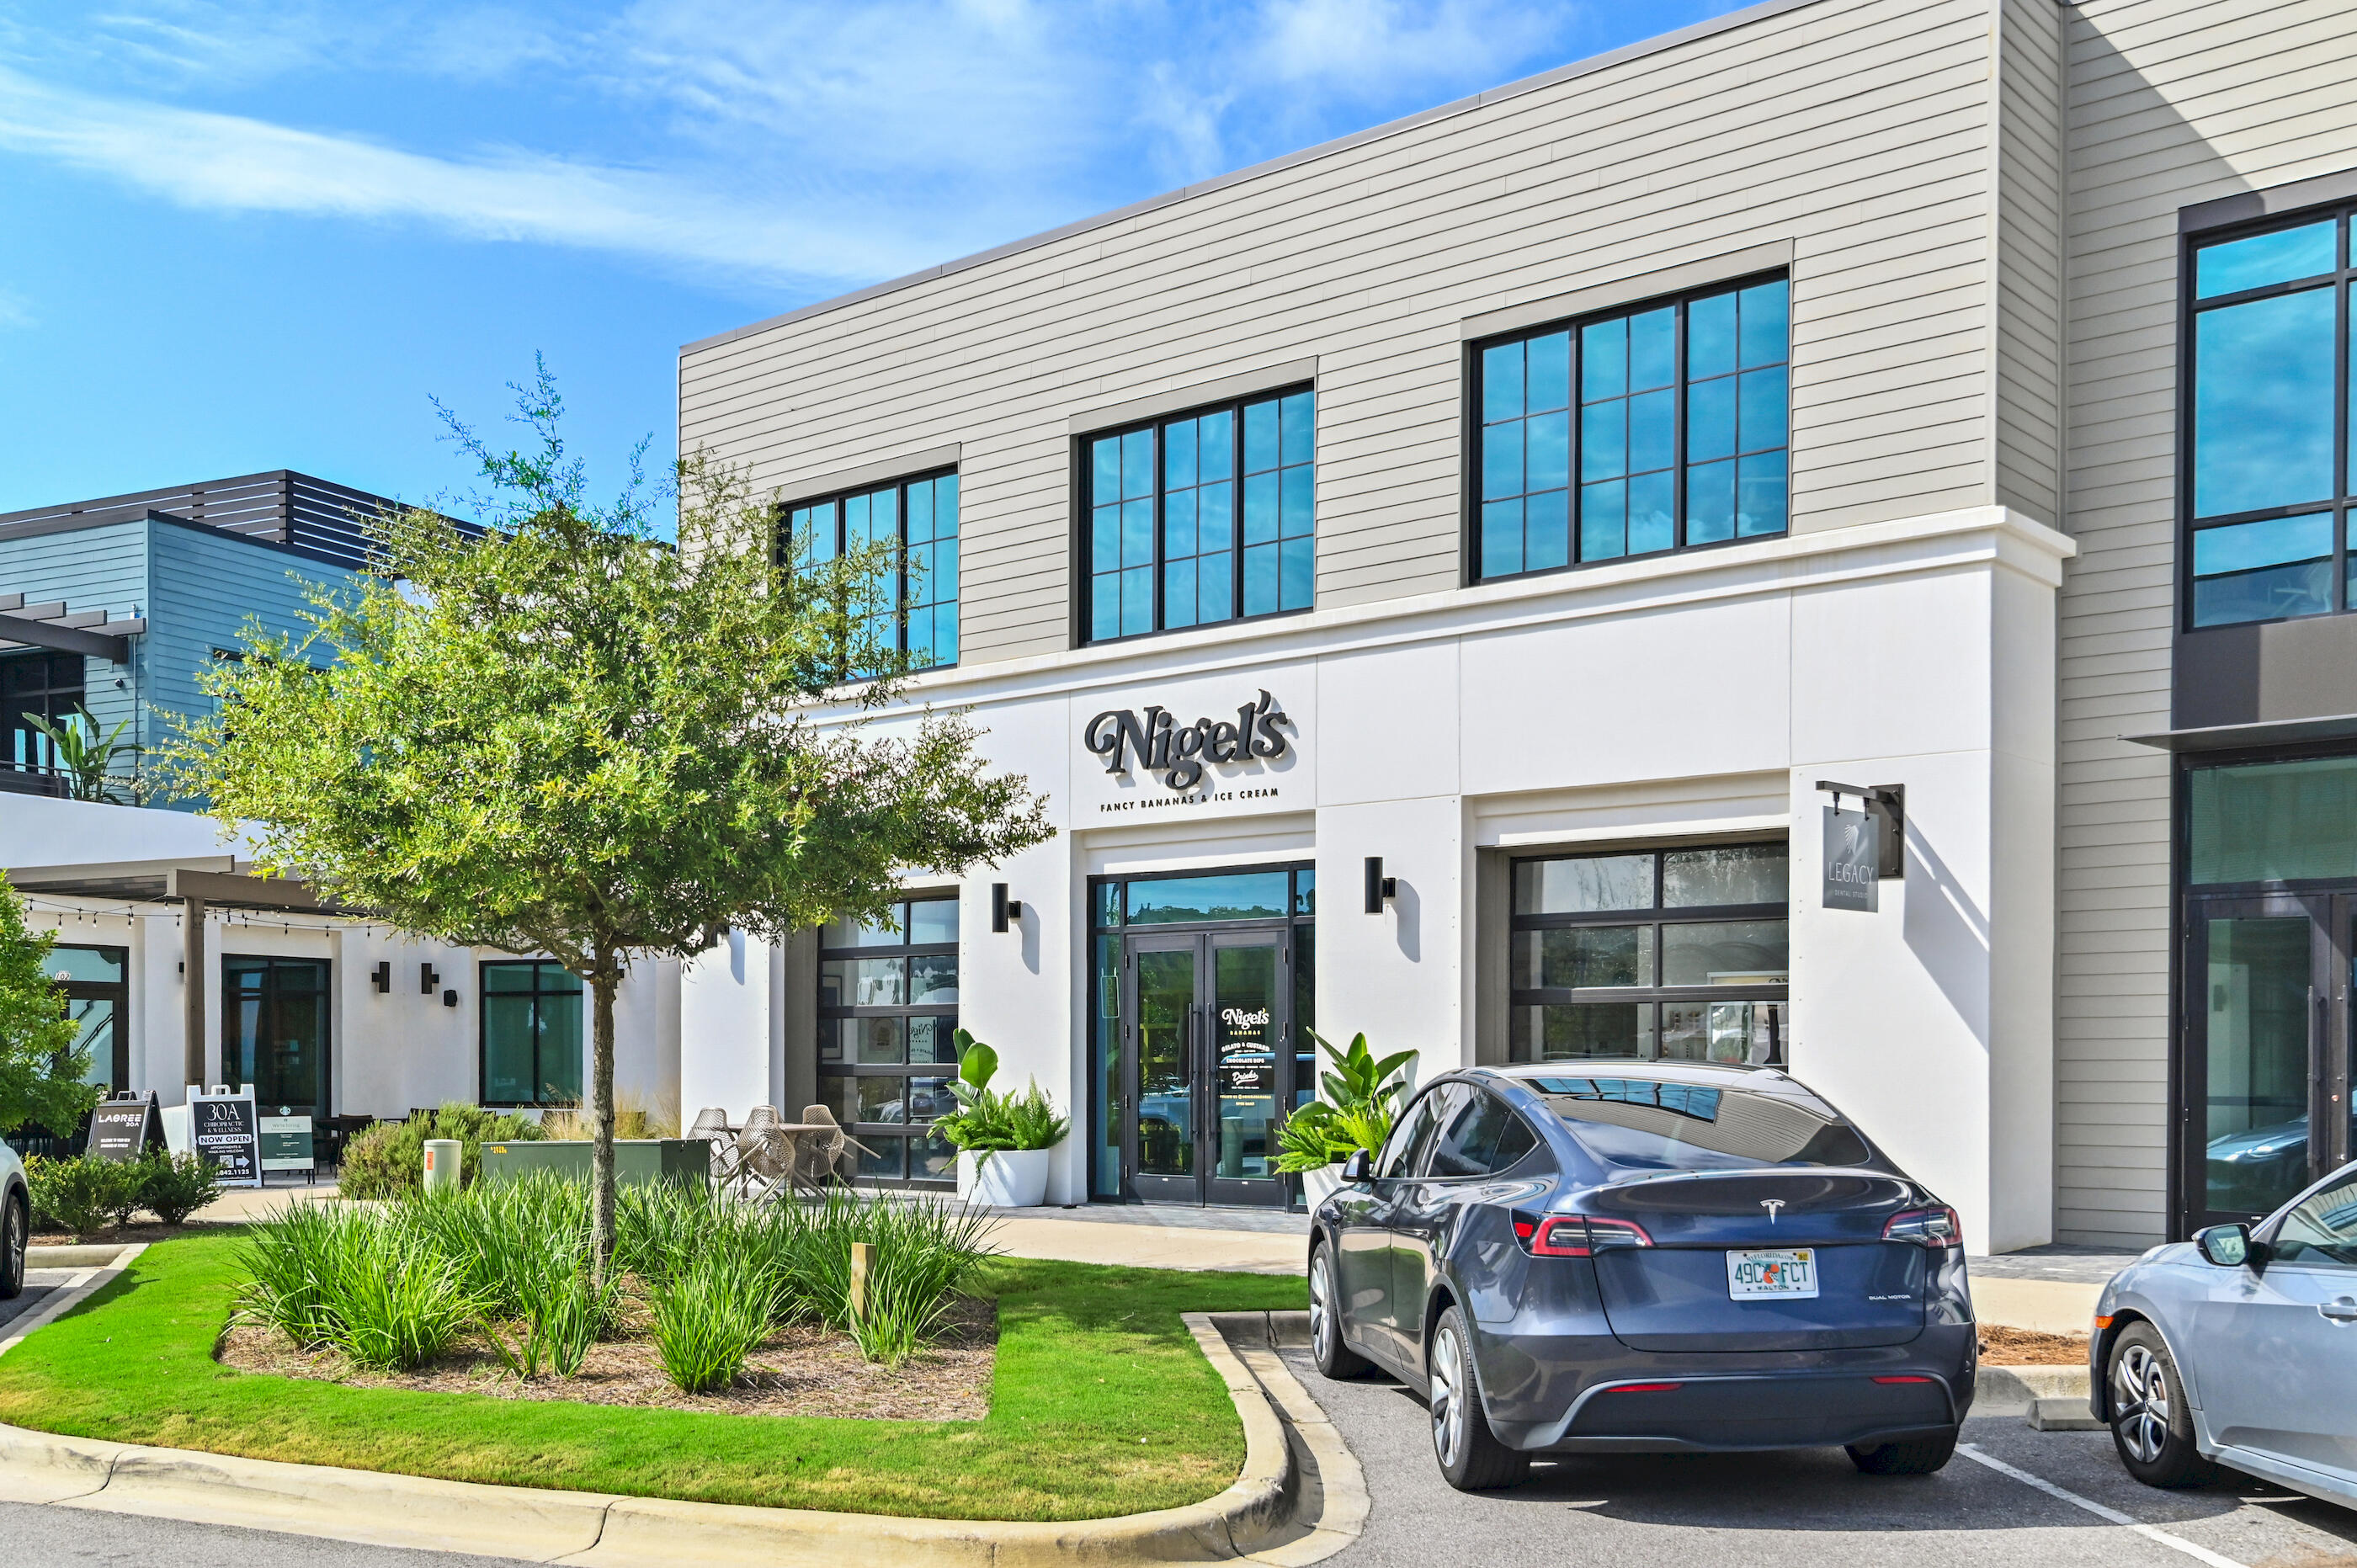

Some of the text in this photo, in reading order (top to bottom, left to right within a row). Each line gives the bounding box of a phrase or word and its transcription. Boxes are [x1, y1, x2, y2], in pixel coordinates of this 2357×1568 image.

[1084, 688, 1288, 790] Nigel's
[1100, 788, 1279, 812] FANCY BANANAS & ICE CREAM
[1828, 861, 1874, 885] LEGACY
[1834, 889, 1851, 897] DENTAL
[1221, 1007, 1269, 1030] Nigel's
[1221, 1042, 1241, 1052] GELATO
[1232, 1070, 1258, 1085] Drinks
[98, 1114, 142, 1123] LAGREE
[206, 1103, 241, 1121] 30A
[1735, 1262, 1808, 1284] 49C FCT
